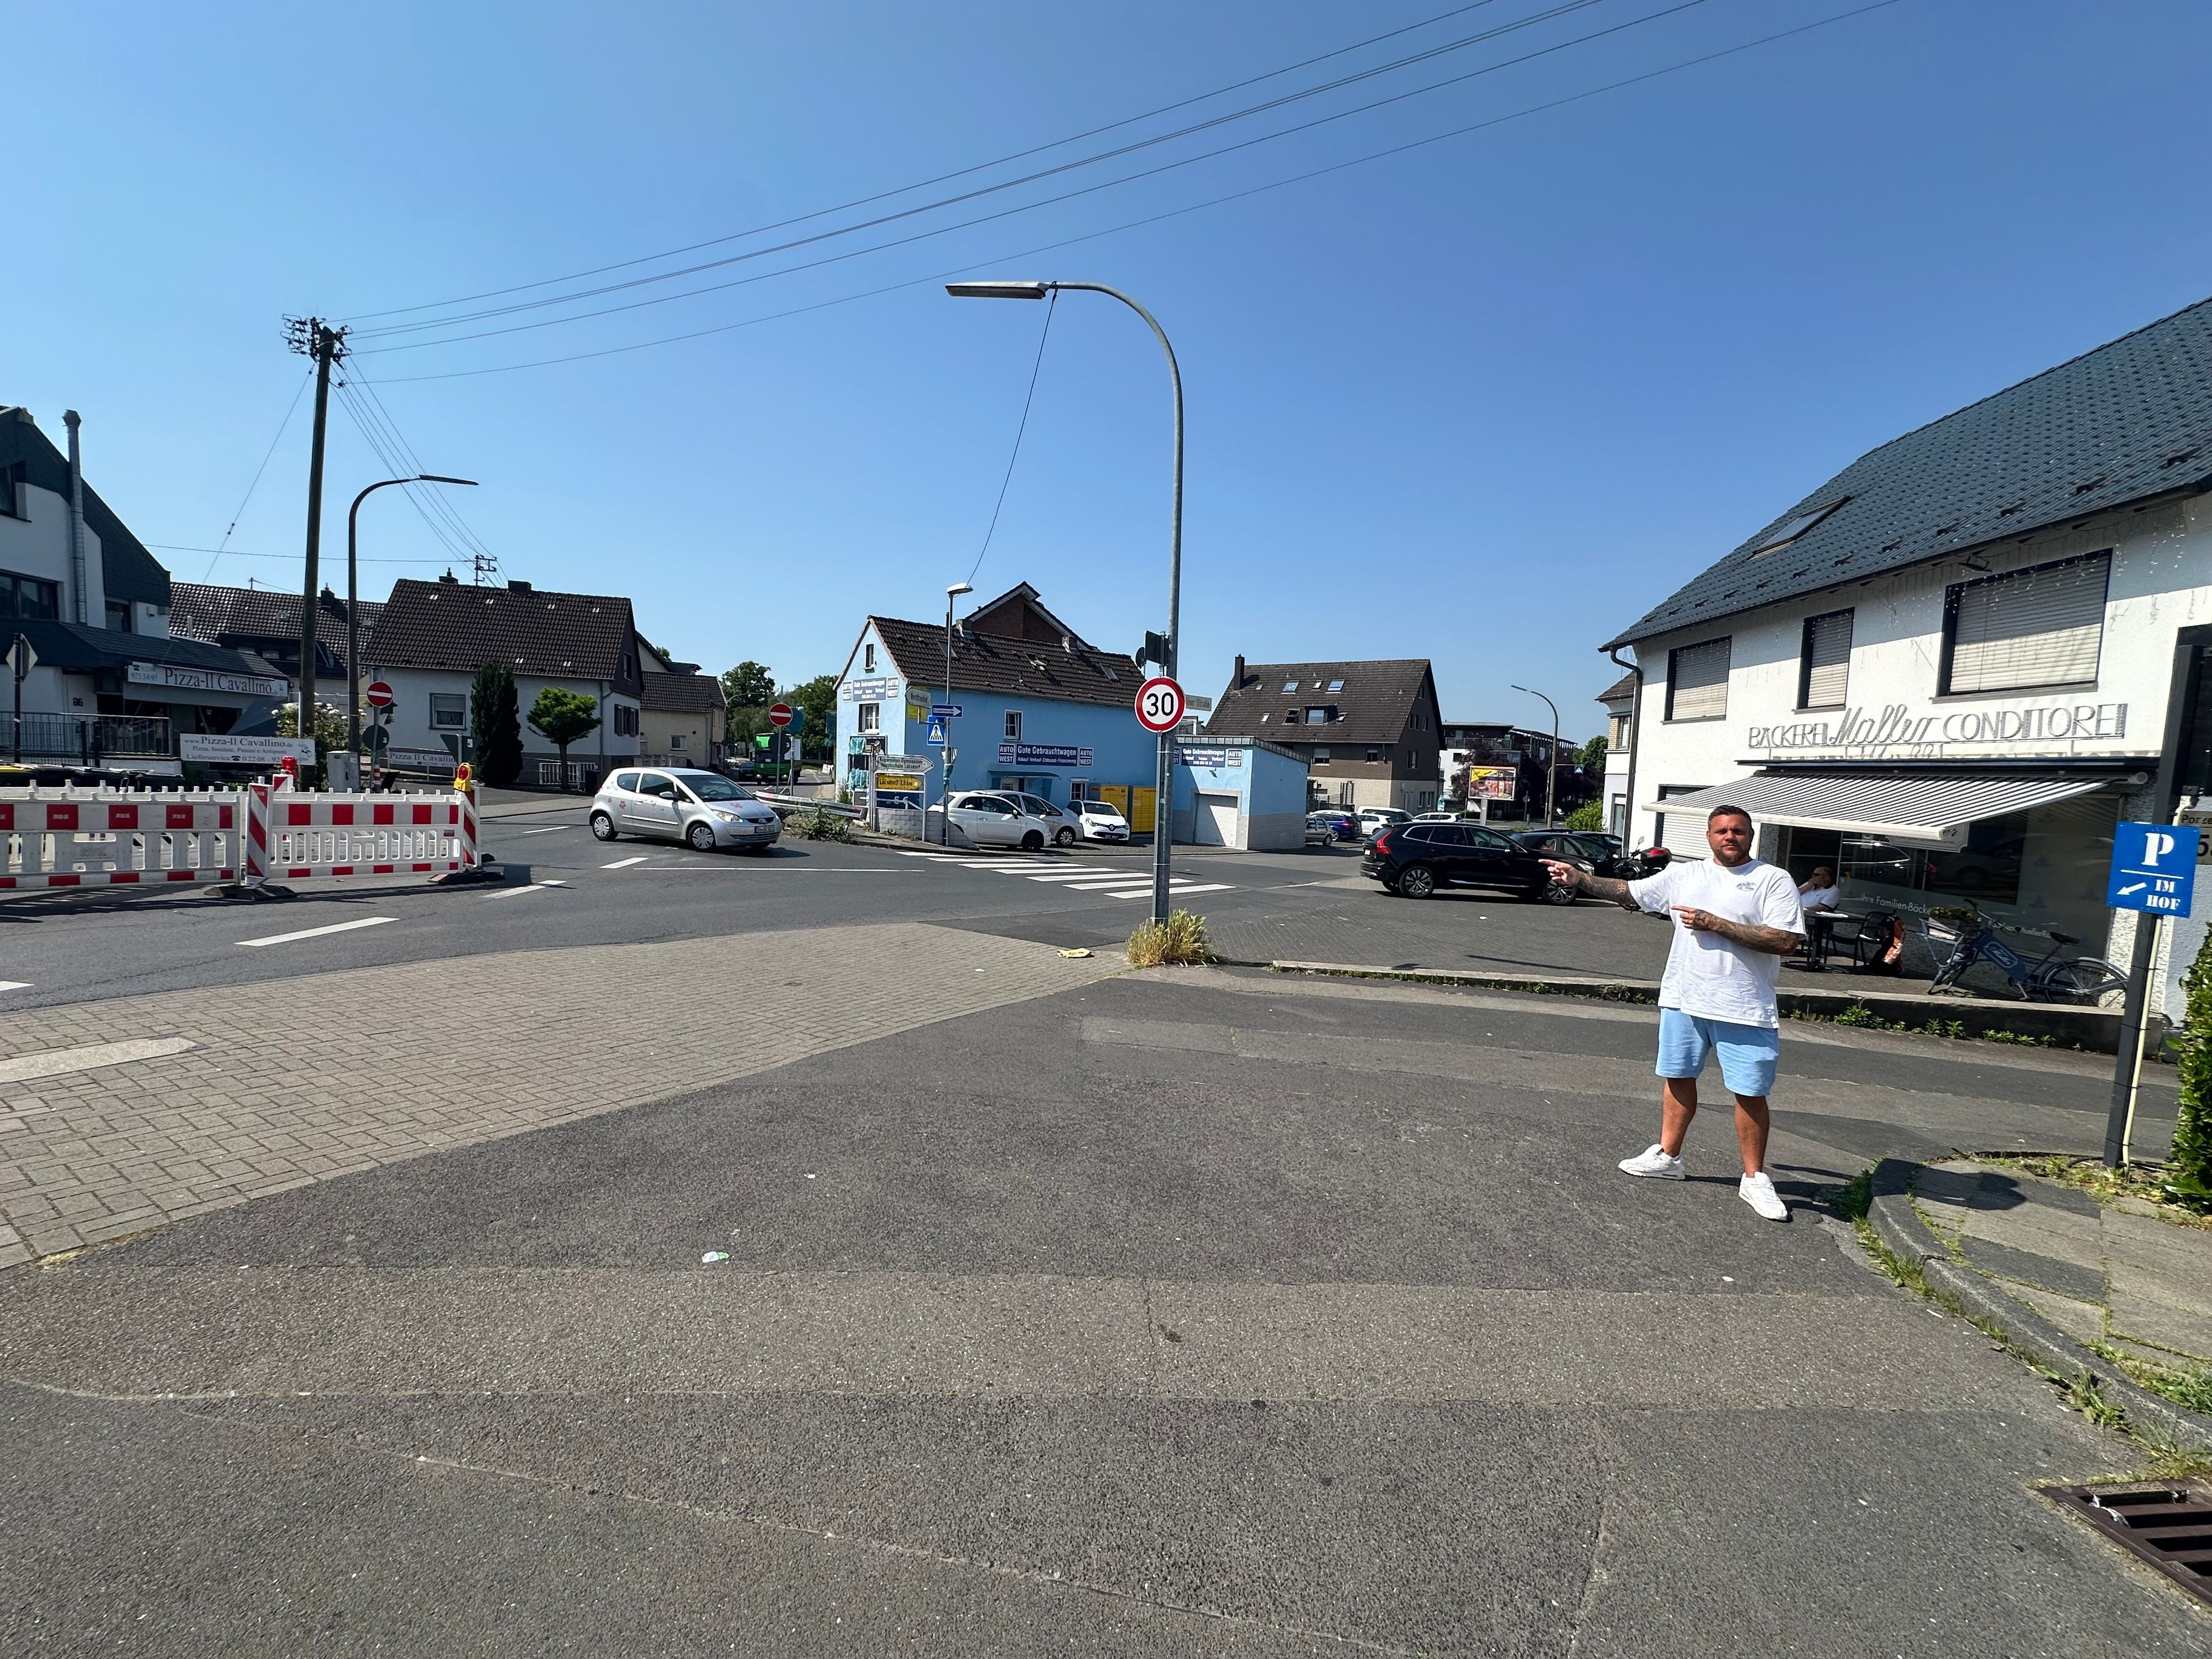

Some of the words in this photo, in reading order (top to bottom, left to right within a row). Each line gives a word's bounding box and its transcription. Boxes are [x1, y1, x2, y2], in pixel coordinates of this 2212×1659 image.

[165, 667, 213, 688] Pizza-Il
[73, 697, 83, 707] 86
[1146, 692, 1174, 717] 30
[1749, 723, 1828, 747] BÄCKEREI
[1943, 703, 2128, 740] CONDITOREI
[423, 754, 455, 763] Cavallin
[1032, 747, 1076, 757] Gebrauchtwagen
[2141, 832, 2174, 866] P
[2197, 834, 2212, 857] 5
[2154, 879, 2176, 893] IM
[1861, 892, 1874, 904] Ihre
[1876, 896, 1931, 915] Familien-Bäcke
[2146, 894, 2180, 910] HOF
